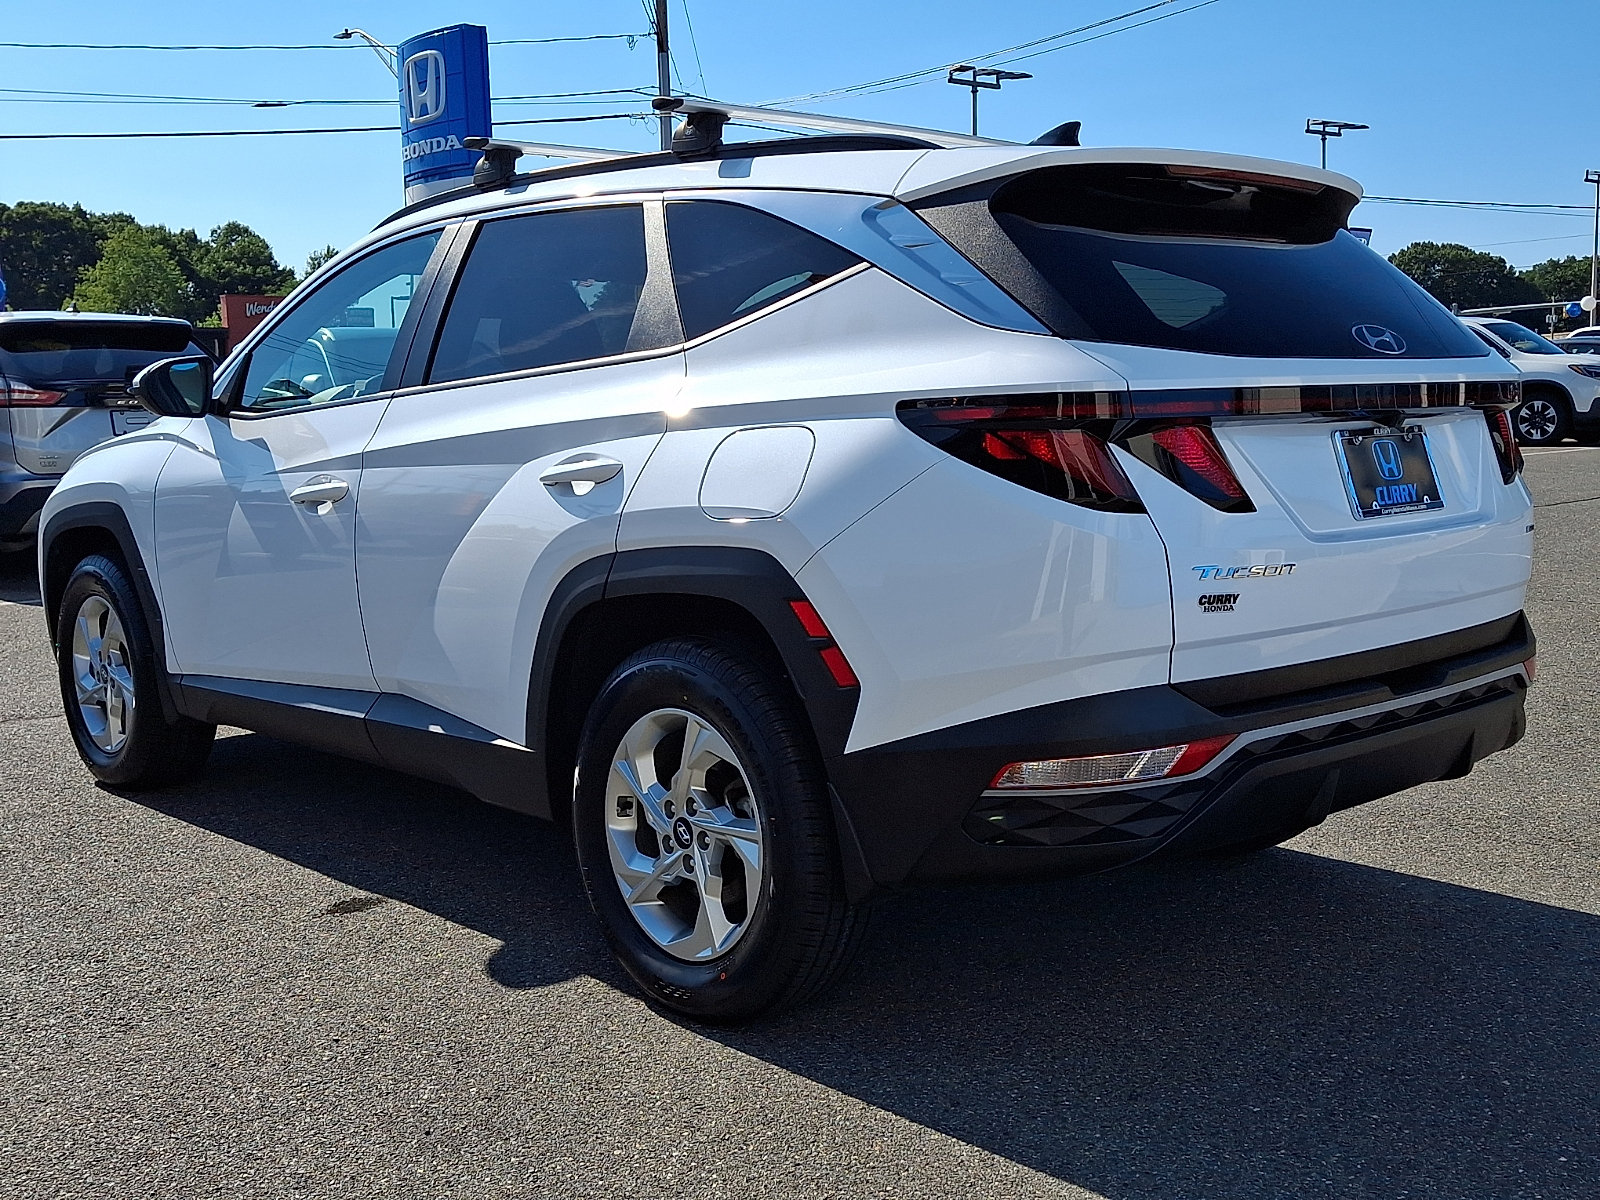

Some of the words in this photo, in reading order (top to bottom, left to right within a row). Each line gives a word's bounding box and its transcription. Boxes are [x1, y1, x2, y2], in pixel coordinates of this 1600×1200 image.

[402, 134, 463, 161] HONDA
[246, 301, 277, 316] Wend
[1376, 483, 1418, 505] CURRY
[1198, 593, 1240, 606] CURRY
[1203, 605, 1235, 613] HONDA
